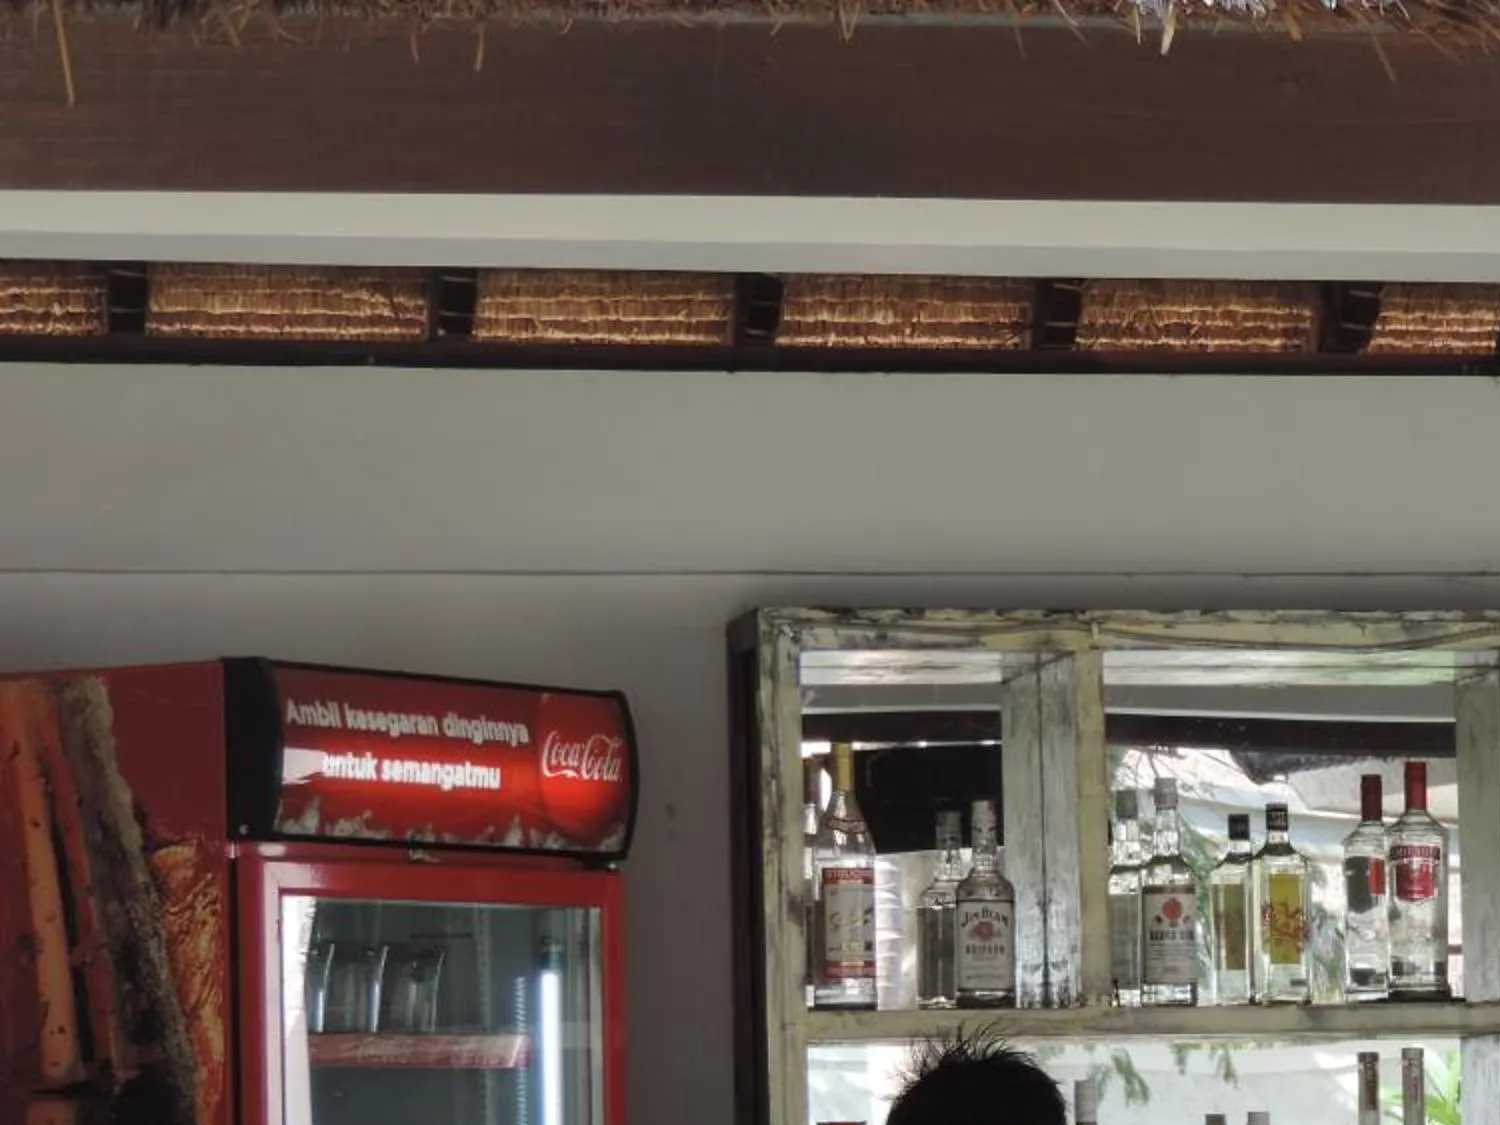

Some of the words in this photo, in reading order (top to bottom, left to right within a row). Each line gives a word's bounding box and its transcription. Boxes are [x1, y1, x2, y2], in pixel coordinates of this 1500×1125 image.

[286, 699, 341, 730] Ambil
[345, 705, 440, 738] kesegaran
[442, 711, 529, 746] dinginnya
[380, 757, 501, 791] semangatmu
